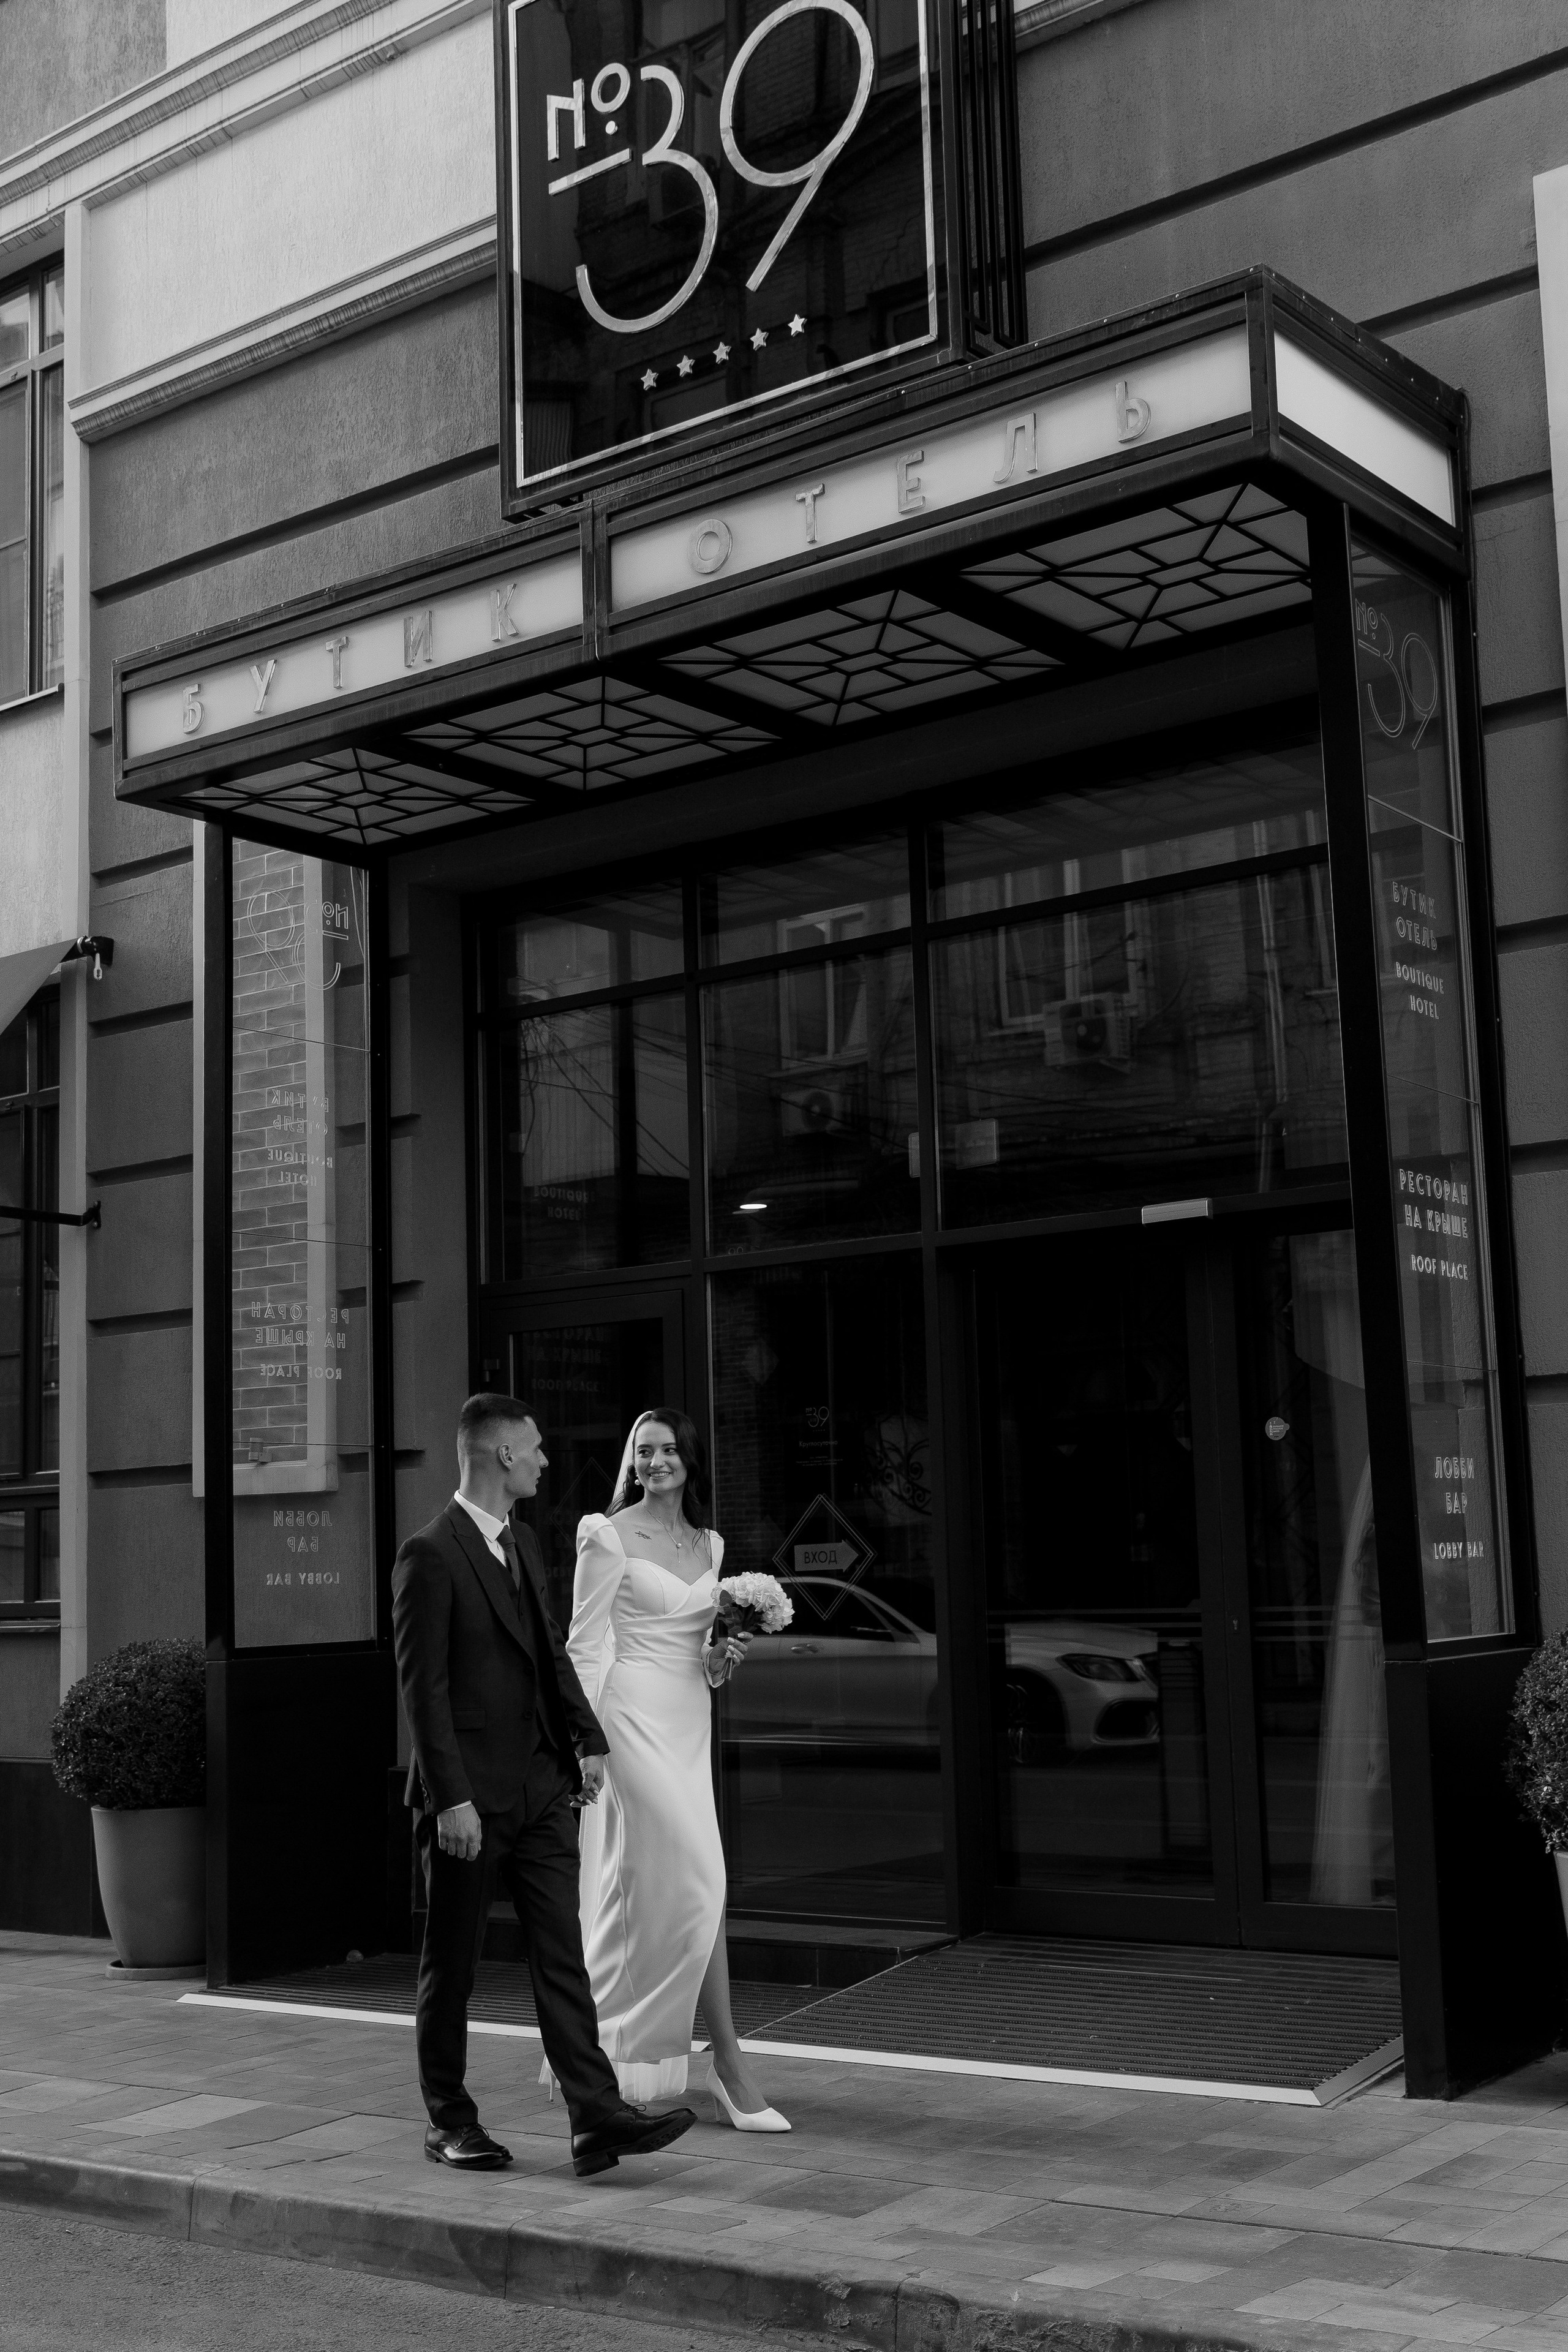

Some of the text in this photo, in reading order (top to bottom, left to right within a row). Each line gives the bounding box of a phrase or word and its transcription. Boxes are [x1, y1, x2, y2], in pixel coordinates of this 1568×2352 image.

[183, 380, 1152, 734] БУТИК ОТЕЛЬ
[1392, 881, 1437, 919] БУТИК
[1396, 916, 1438, 951] ОТЕЛЬ
[1395, 961, 1444, 994] BOUTIQUE
[1410, 995, 1439, 1020] HOTEL
[1399, 1168, 1468, 1205] РЕСТОРАН
[1404, 1204, 1468, 1238] НА КРЫШЕ
[1411, 1254, 1468, 1280] ROOF PLACE
[1434, 1457, 1474, 1479] ЛОББИ
[1446, 1491, 1468, 1514] БАР
[804, 1550, 837, 1565] ВХОД
[1434, 1541, 1484, 1560] LOBBY BAR
